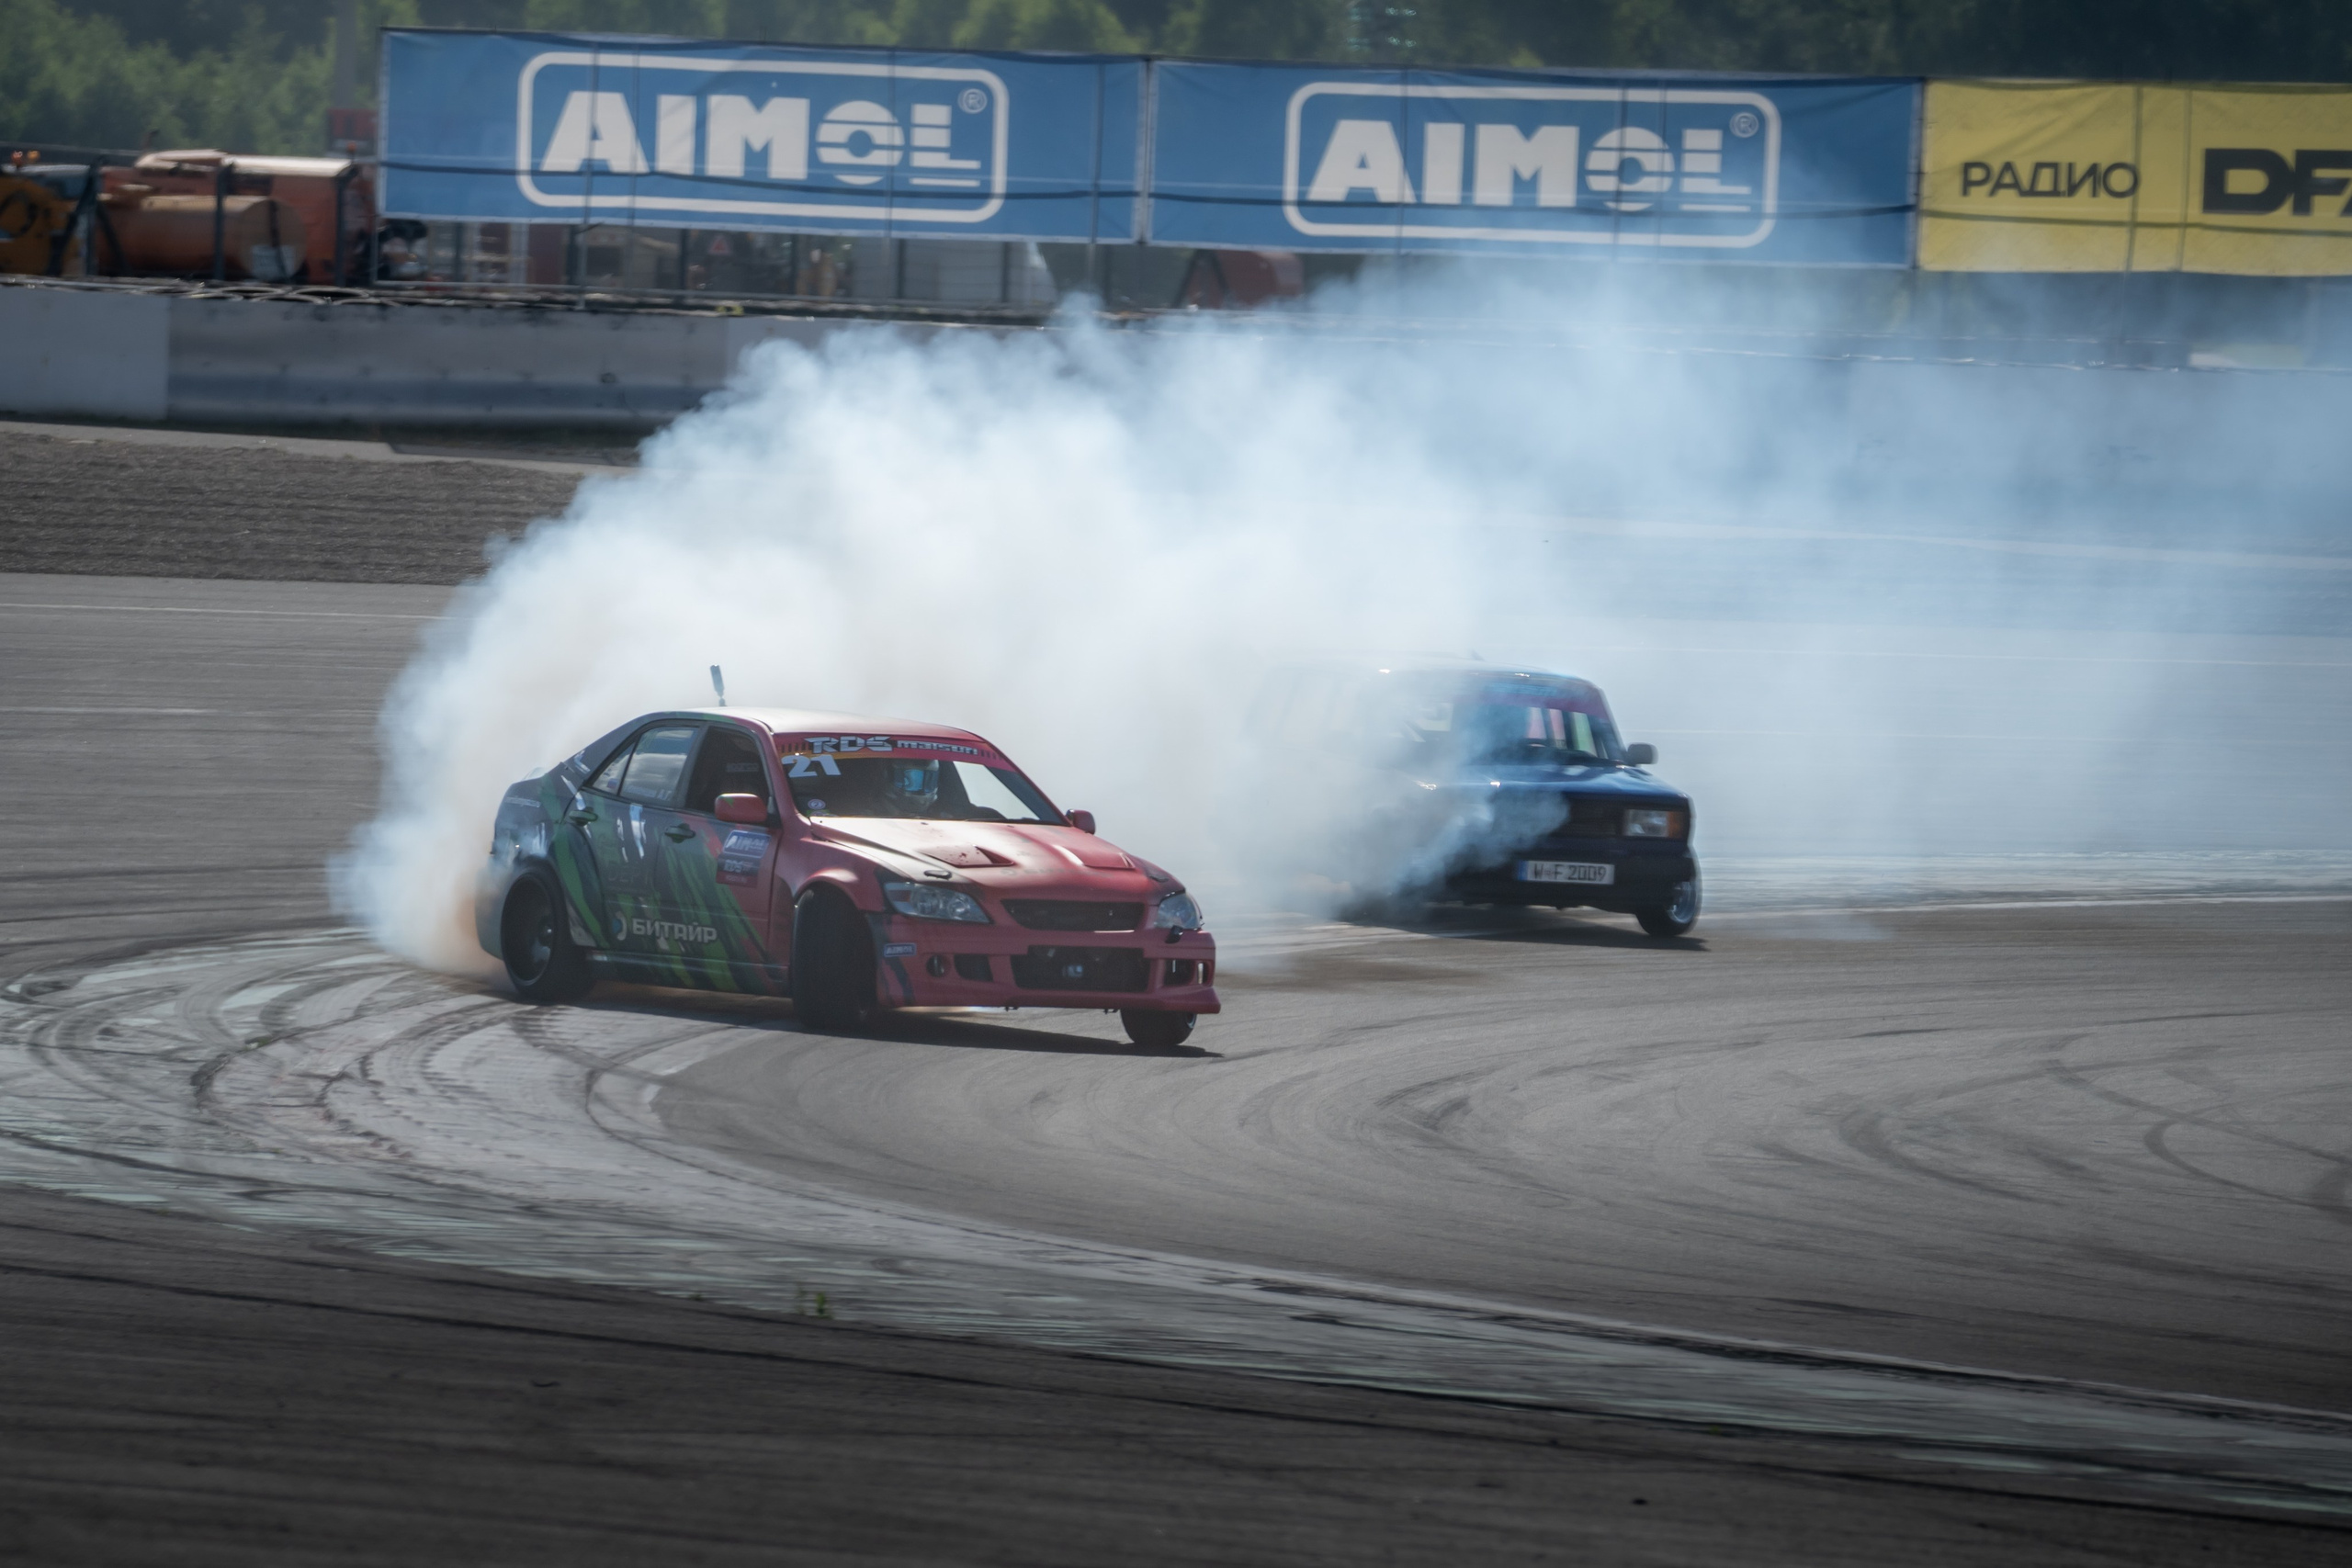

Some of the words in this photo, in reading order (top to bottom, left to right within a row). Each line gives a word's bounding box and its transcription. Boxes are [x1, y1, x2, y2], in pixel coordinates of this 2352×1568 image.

[538, 90, 981, 186] AIMOL
[1306, 118, 1751, 212] AIMOL
[1961, 161, 2141, 199] РАДИО
[2202, 147, 2352, 217] DF
[781, 754, 842, 778] 21
